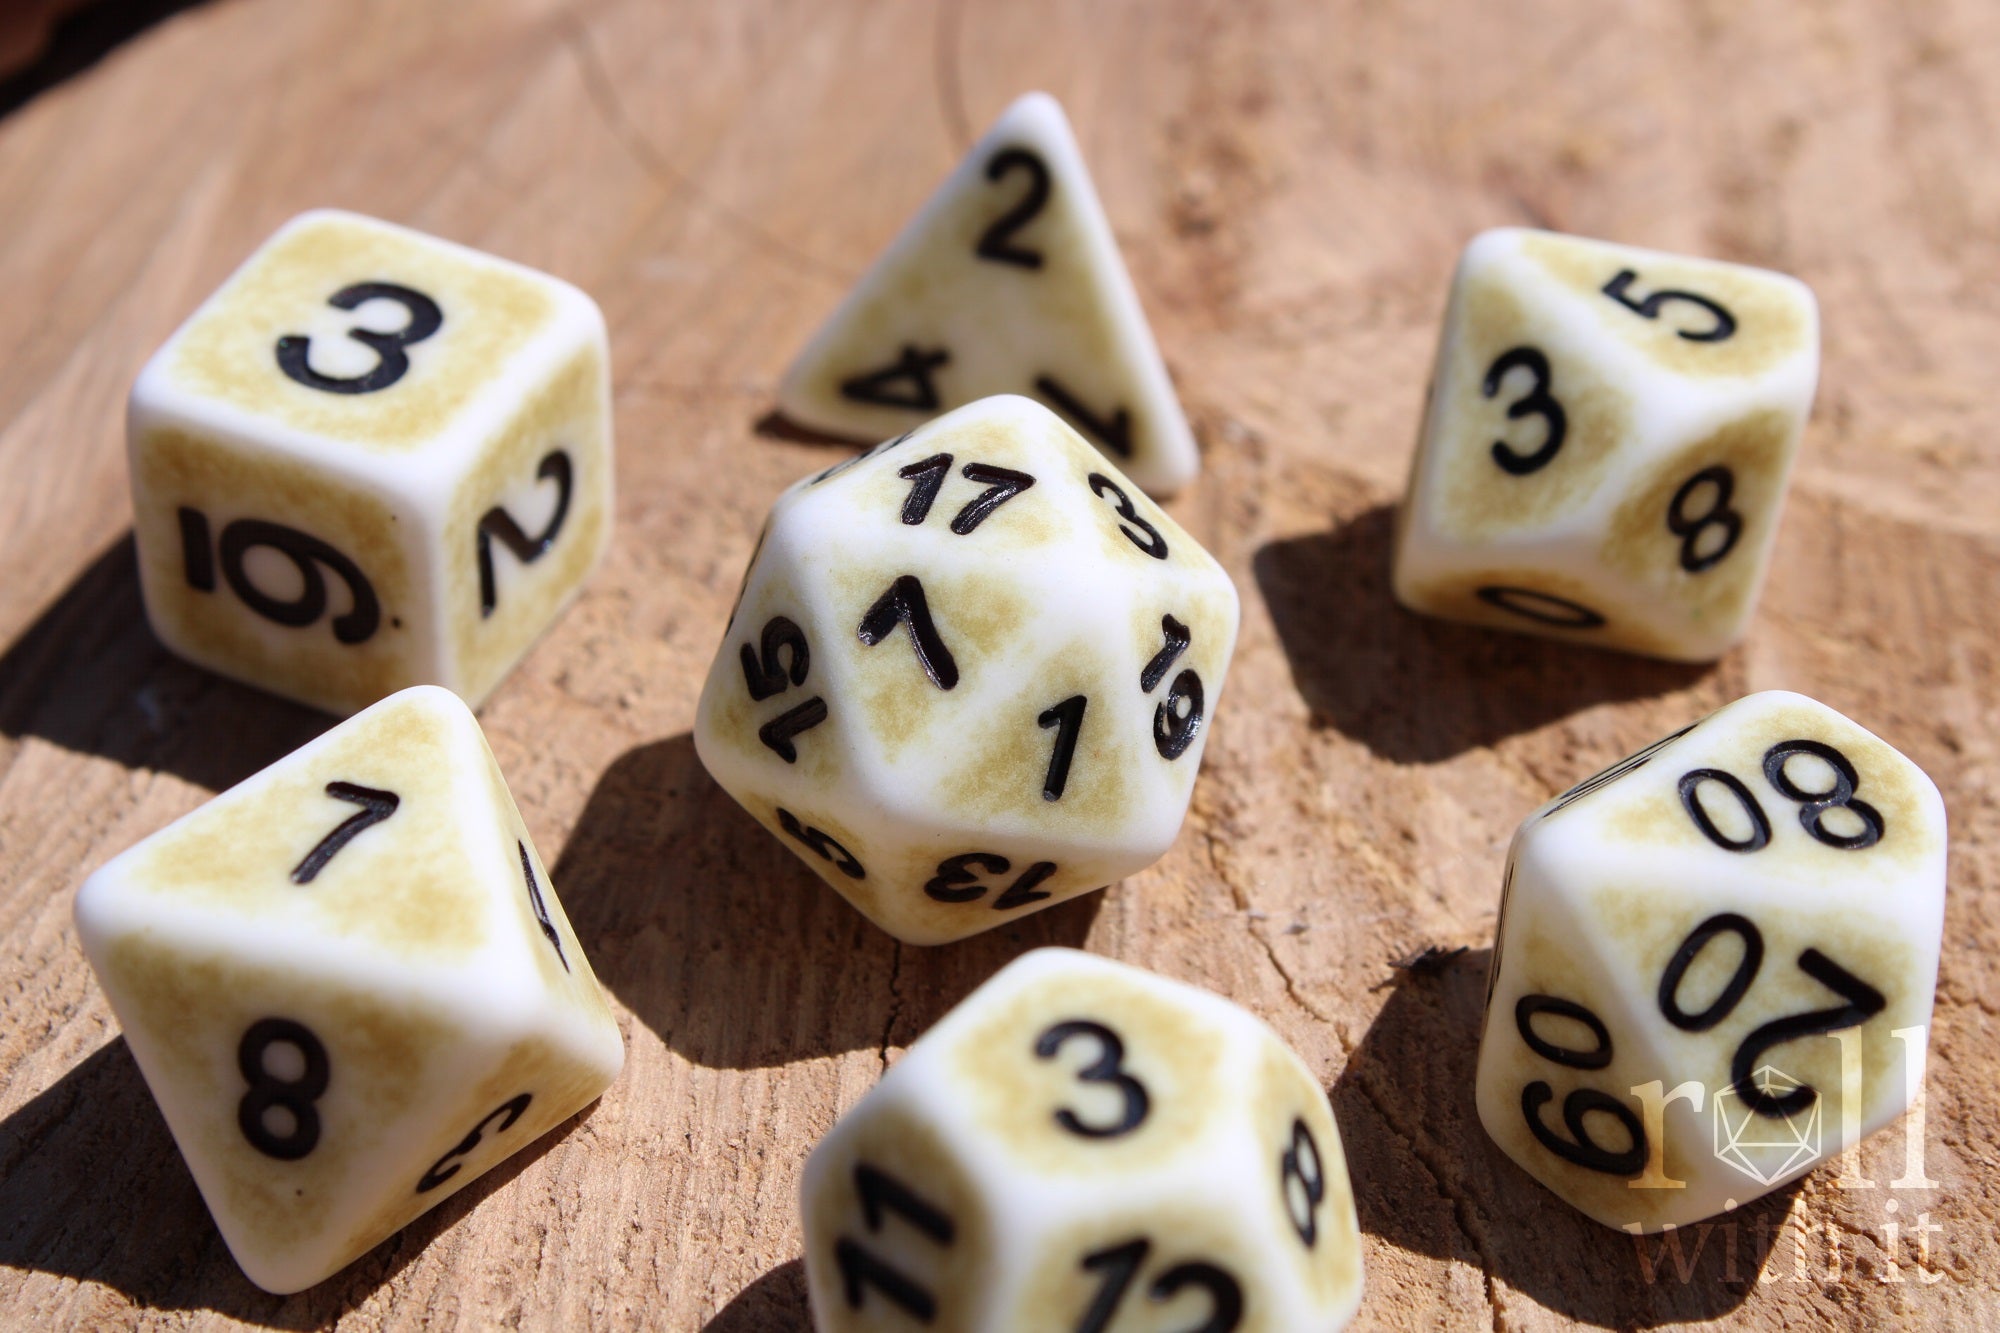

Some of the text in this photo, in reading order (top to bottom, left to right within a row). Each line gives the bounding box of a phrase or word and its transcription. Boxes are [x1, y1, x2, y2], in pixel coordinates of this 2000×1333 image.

[976, 146, 1052, 270] 2
[274, 280, 444, 396] 3
[1602, 268, 1738, 343] 5
[838, 344, 952, 412] 4
[1032, 372, 1134, 462] 1
[1481, 344, 1568, 476] 3
[476, 448, 573, 620] 2
[898, 450, 1038, 536] 17
[1086, 470, 1170, 561] 3
[1666, 464, 1745, 574] 8
[176, 505, 382, 647] 6
[856, 573, 960, 692] 7
[1474, 585, 1608, 640] 0
[737, 613, 829, 765] 15
[1138, 611, 1206, 762] 19
[1036, 693, 1088, 803] 1
[1676, 738, 1886, 854] 80
[290, 780, 400, 886] 7
[922, 851, 1058, 911] 13
[1656, 912, 1887, 1121] 20
[238, 1018, 331, 1162] 8
[1033, 1018, 1150, 1138] 3
[1514, 994, 1650, 1177] 60
[415, 1092, 534, 1195] 3
[1281, 1116, 1326, 1250] 8
[832, 1160, 958, 1326] 11
